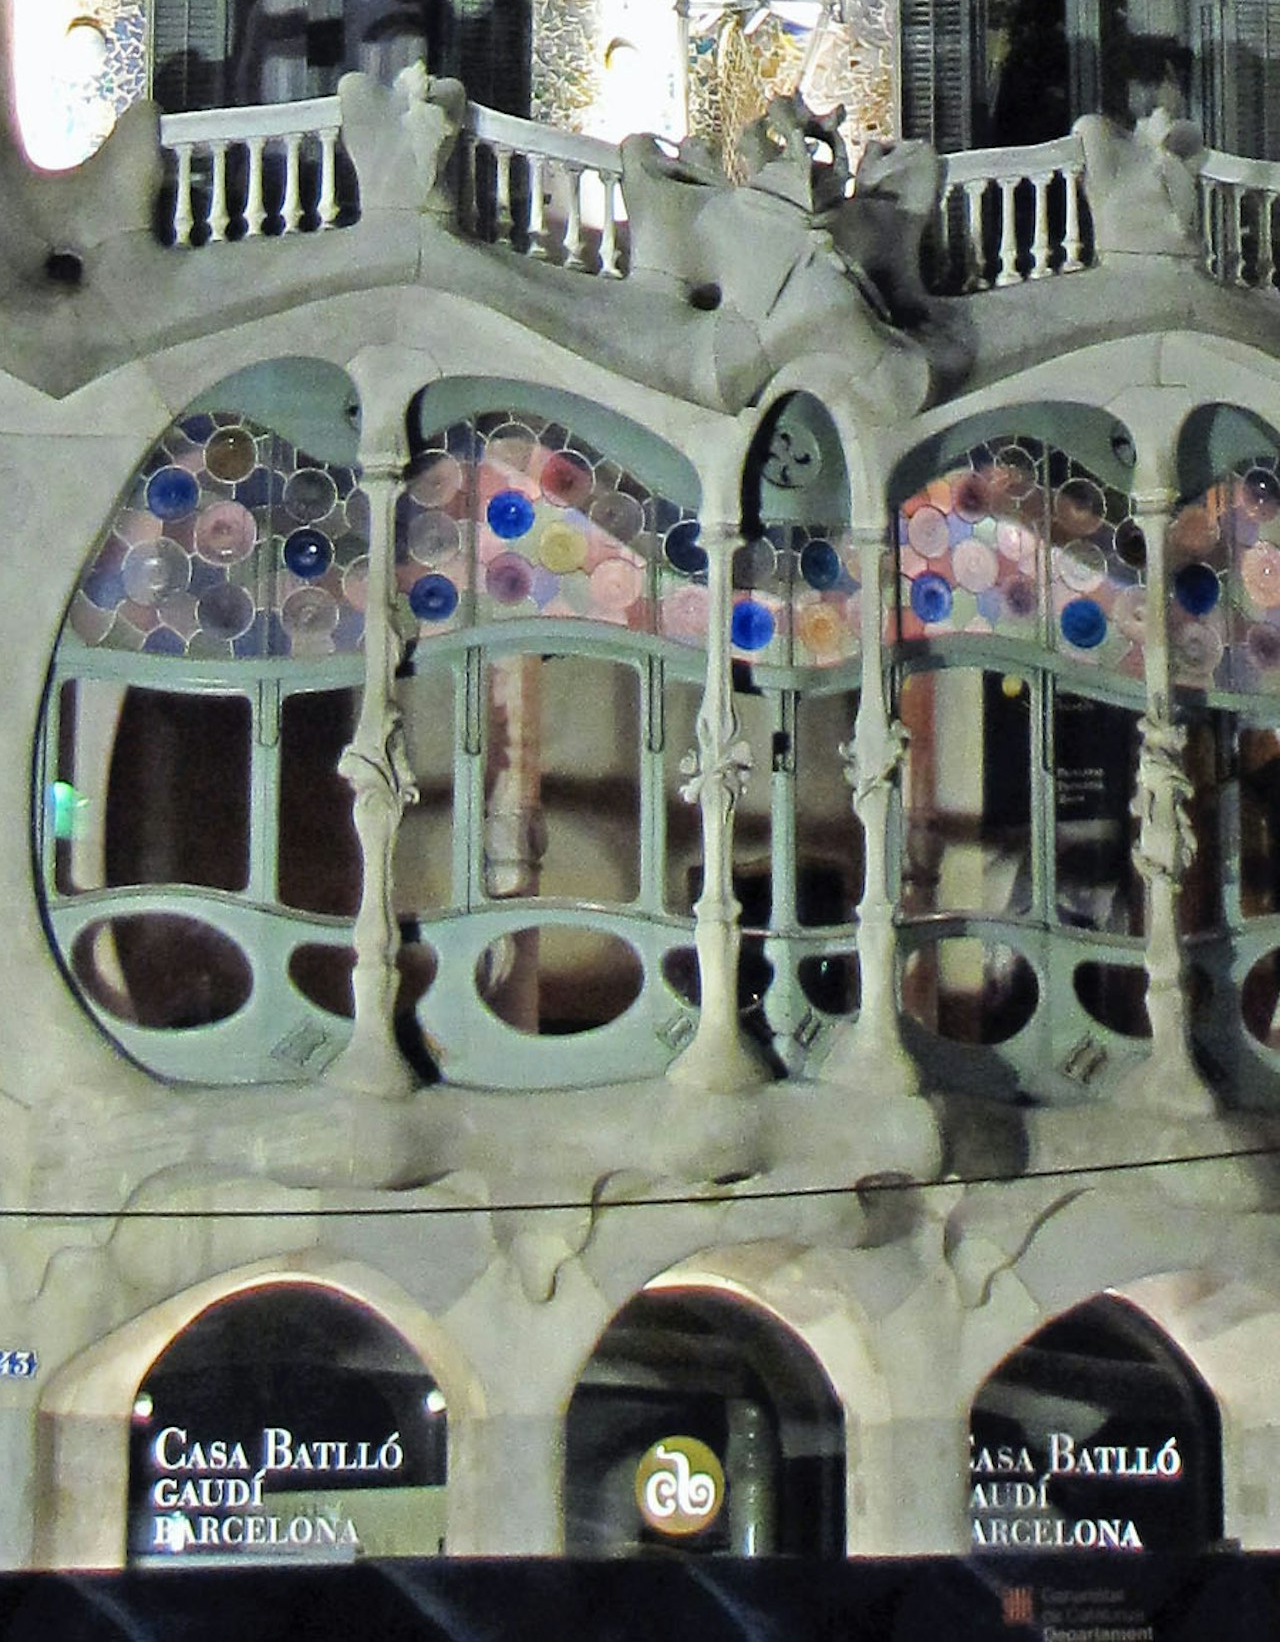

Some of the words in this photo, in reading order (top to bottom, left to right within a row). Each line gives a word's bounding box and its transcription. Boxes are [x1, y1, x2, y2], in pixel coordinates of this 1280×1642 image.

[153, 1468, 267, 1507] GAUDÍ
[153, 1515, 360, 1545] BARCELONA
[971, 1518, 1144, 1548] ARCELONA
